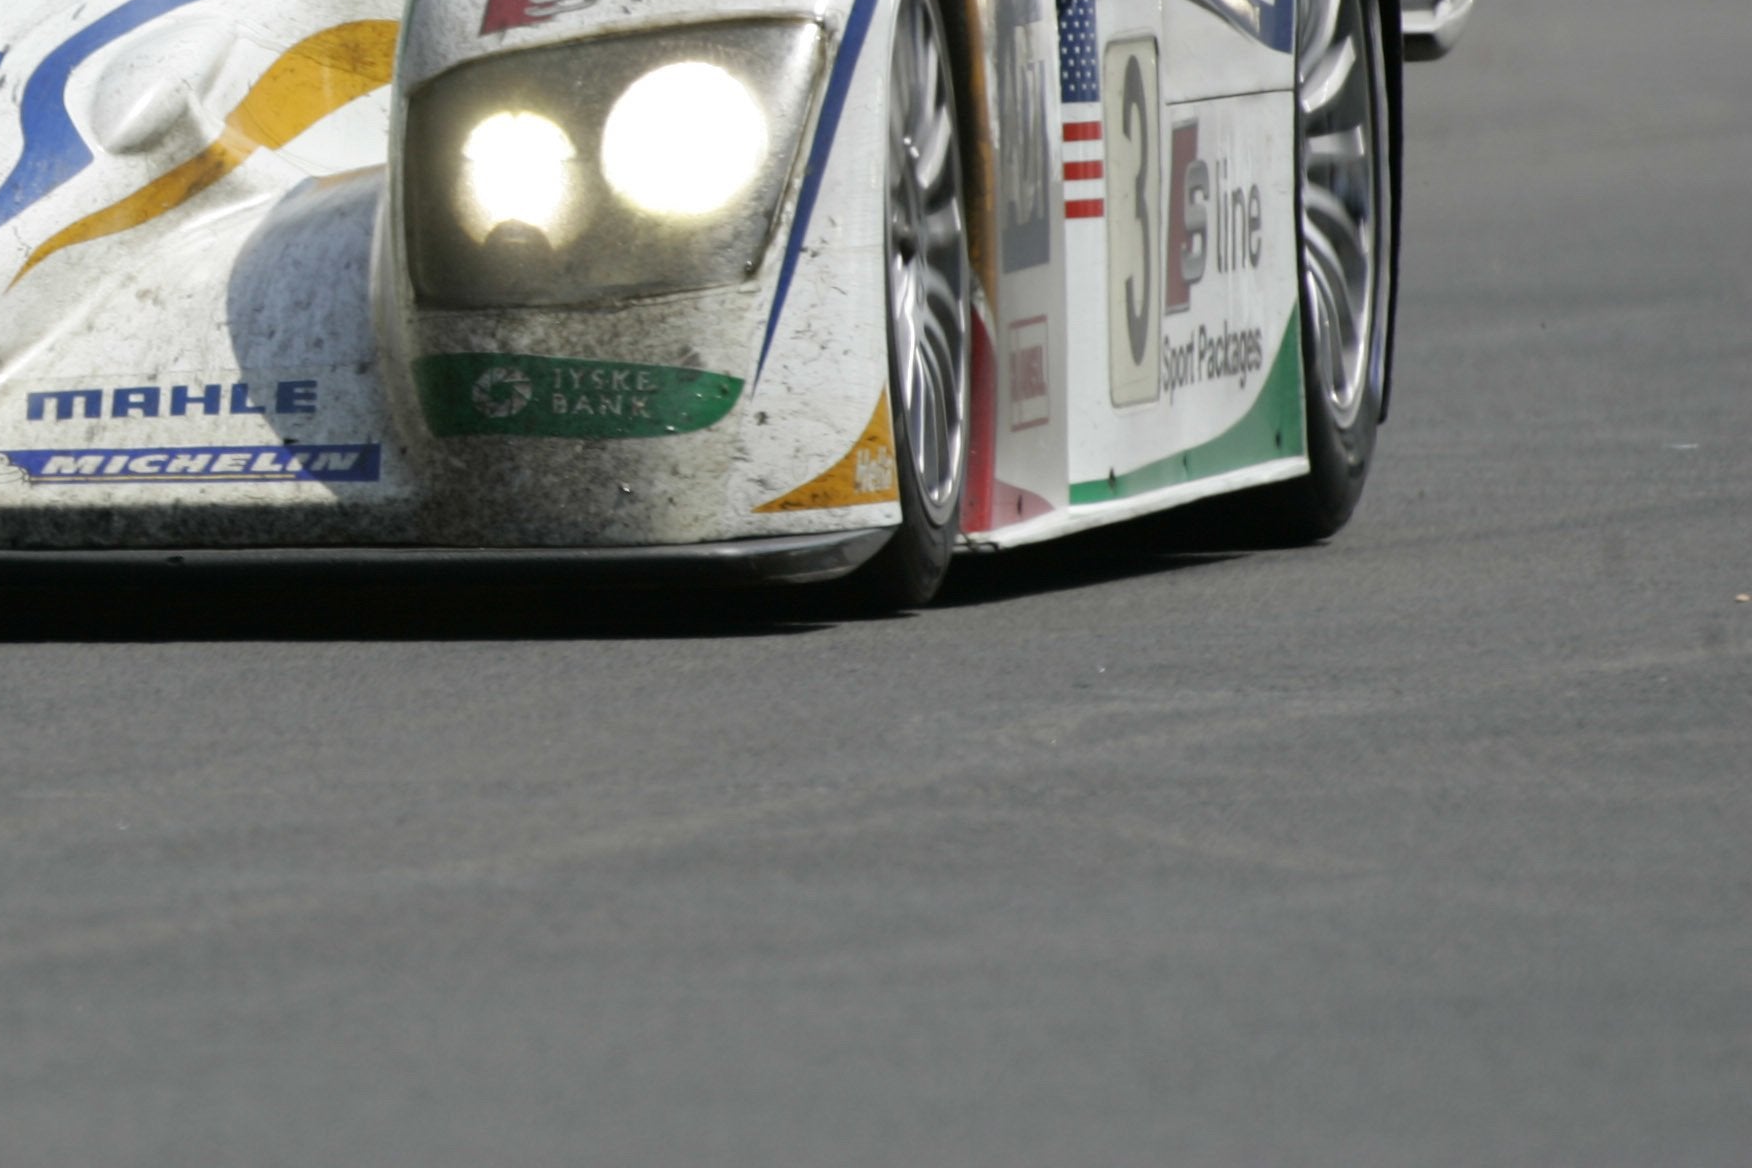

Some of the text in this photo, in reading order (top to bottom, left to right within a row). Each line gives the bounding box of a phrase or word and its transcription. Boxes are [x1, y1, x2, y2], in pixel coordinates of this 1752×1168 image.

[1123, 54, 1150, 367] 3
[1181, 156, 1262, 285] S line
[1162, 320, 1263, 406] Sport Packages
[26, 379, 318, 421] MAHLE
[551, 393, 651, 418] BANK
[40, 450, 362, 477] MICHELIN
